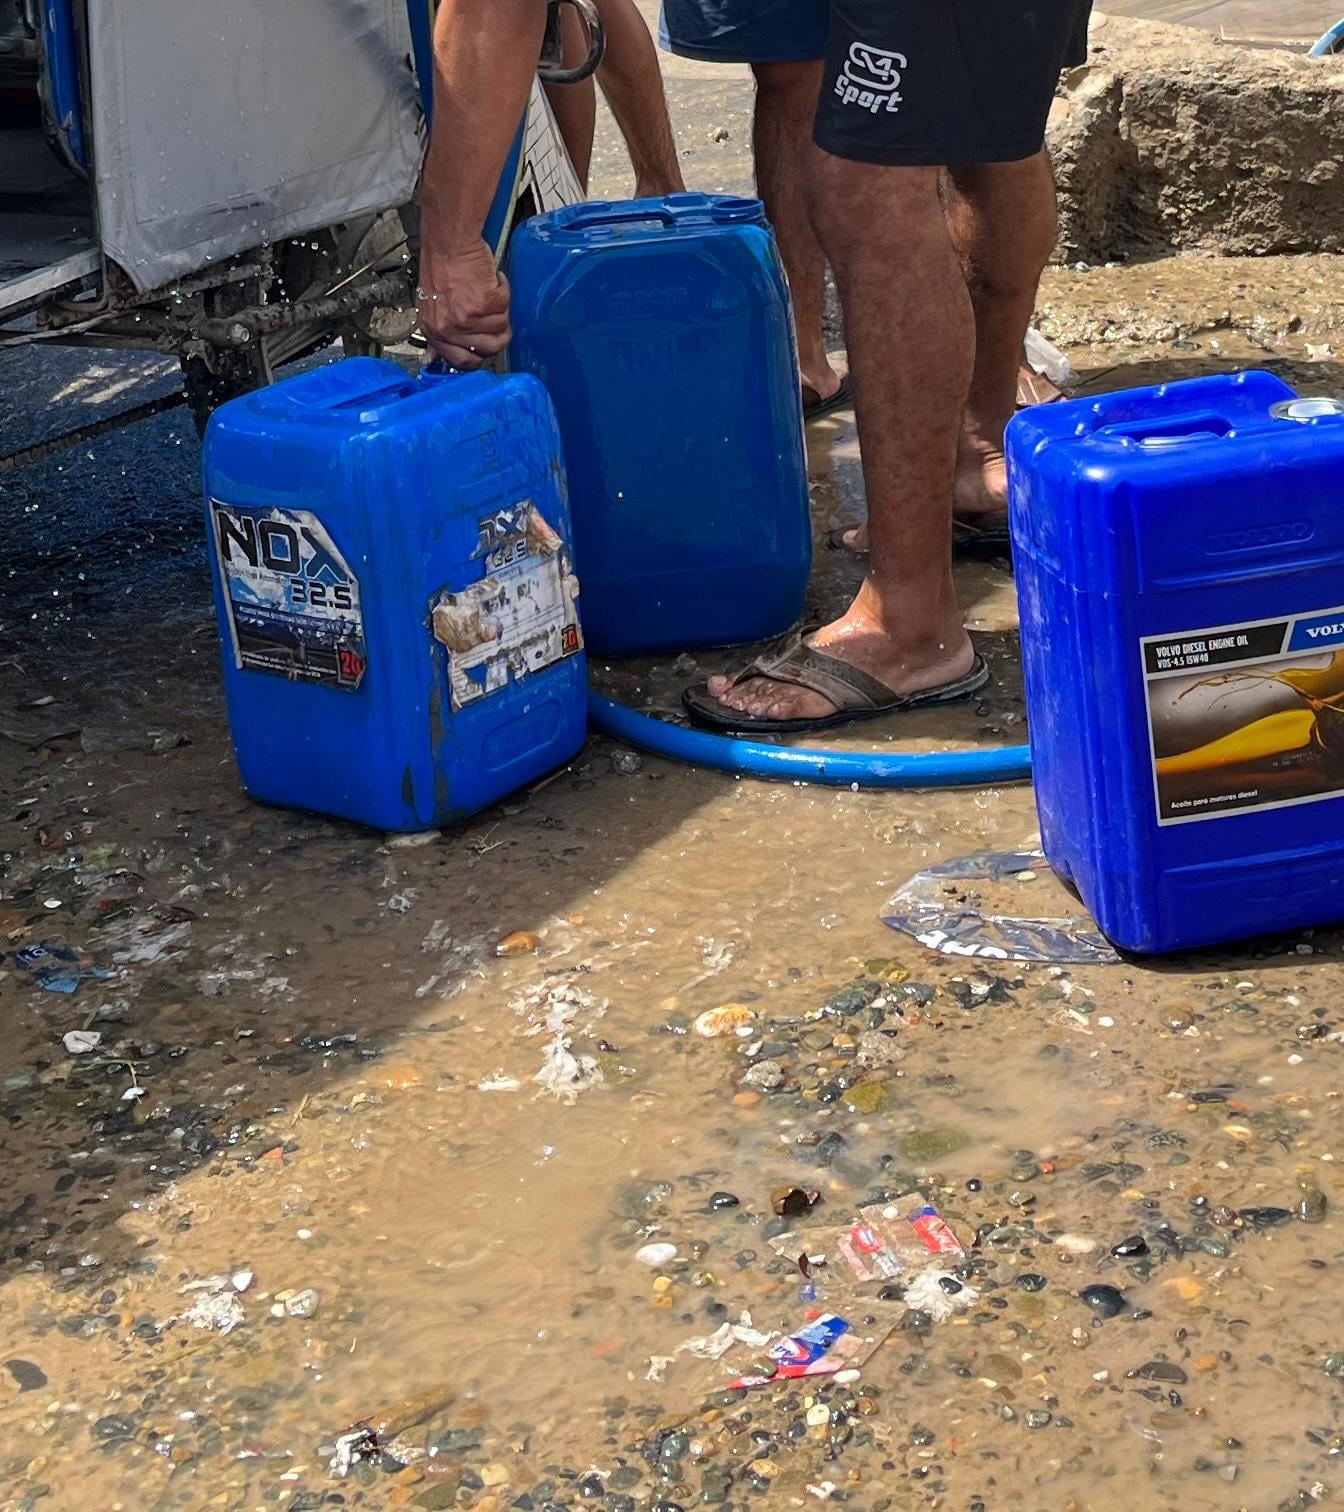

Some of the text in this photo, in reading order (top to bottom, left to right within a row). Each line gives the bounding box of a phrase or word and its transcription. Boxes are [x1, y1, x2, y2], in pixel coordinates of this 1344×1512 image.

[290, 578, 352, 610] 32.5
[1156, 635, 1249, 658] VOLVO DIESEL ENGINE OIL
[1157, 657, 1185, 669] VDS-4.5
